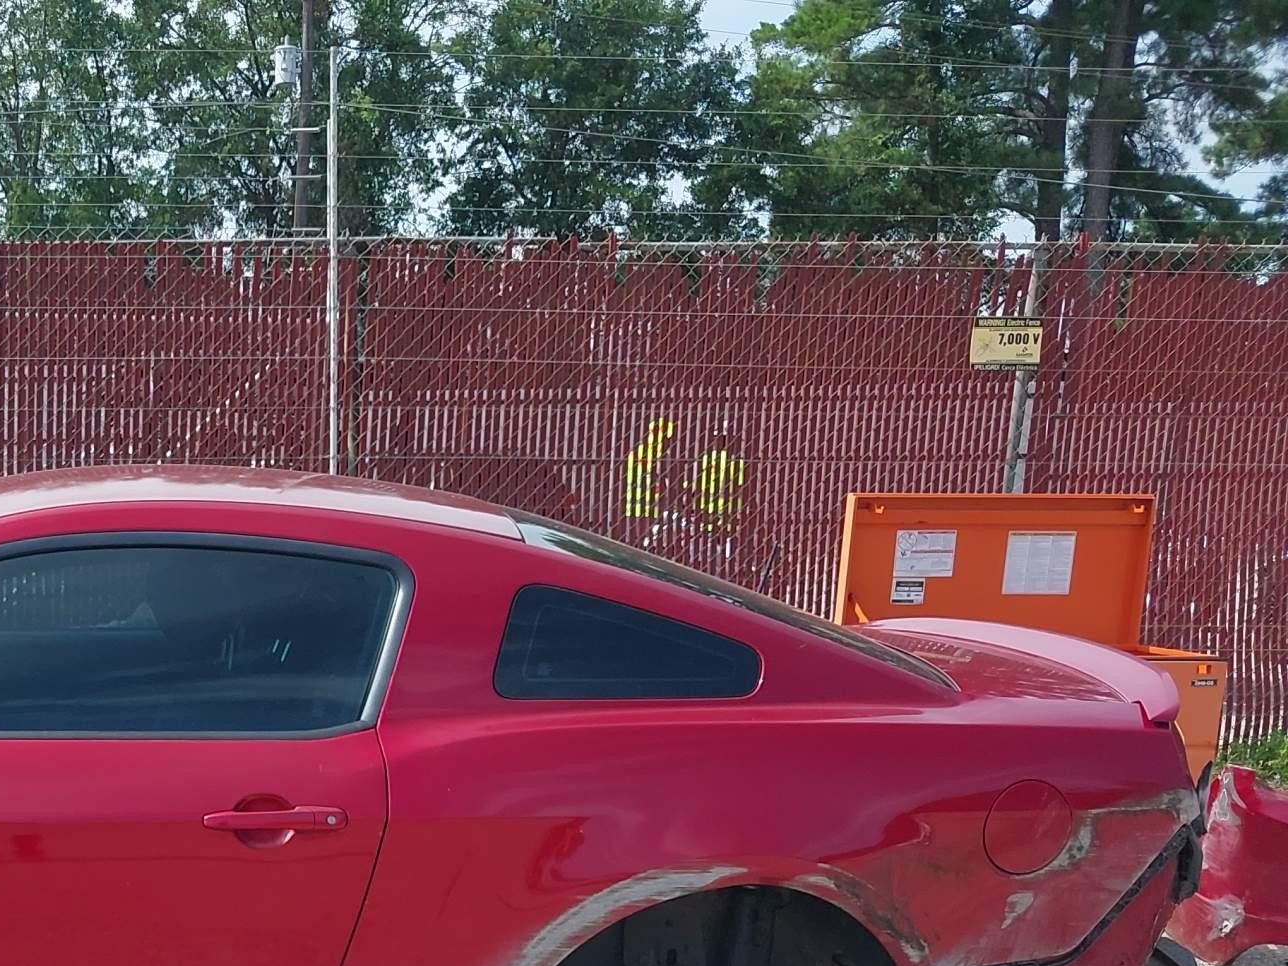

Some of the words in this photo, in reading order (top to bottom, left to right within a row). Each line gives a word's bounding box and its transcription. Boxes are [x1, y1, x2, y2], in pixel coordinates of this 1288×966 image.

[978, 319, 1006, 327] WARNING!
[1026, 318, 1040, 327] Fence
[998, 333, 1029, 346] 7,000
[1033, 333, 1040, 345] V
